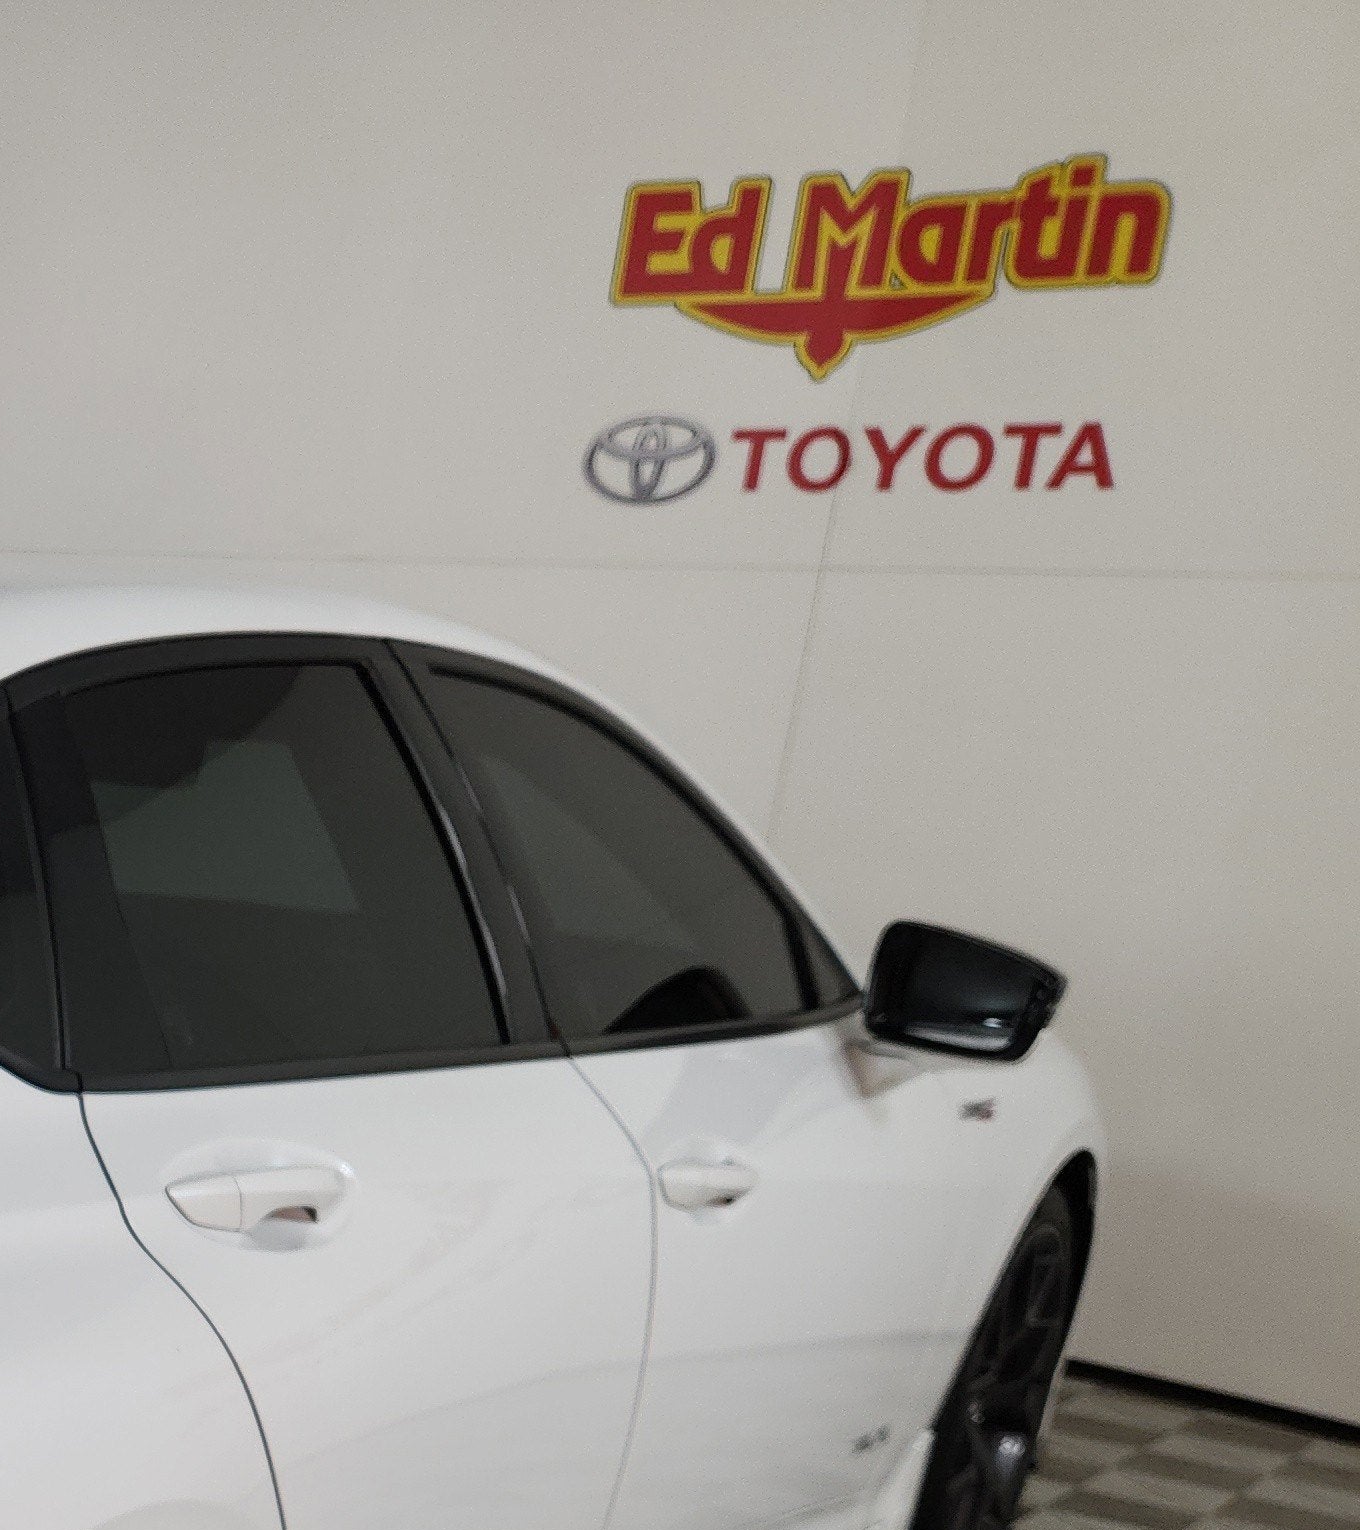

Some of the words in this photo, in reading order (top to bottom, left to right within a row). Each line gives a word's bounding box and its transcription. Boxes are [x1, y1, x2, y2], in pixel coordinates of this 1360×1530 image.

[614, 178, 772, 303] Ed
[784, 154, 1170, 298] Martin
[732, 422, 1114, 492] TOYOTA
